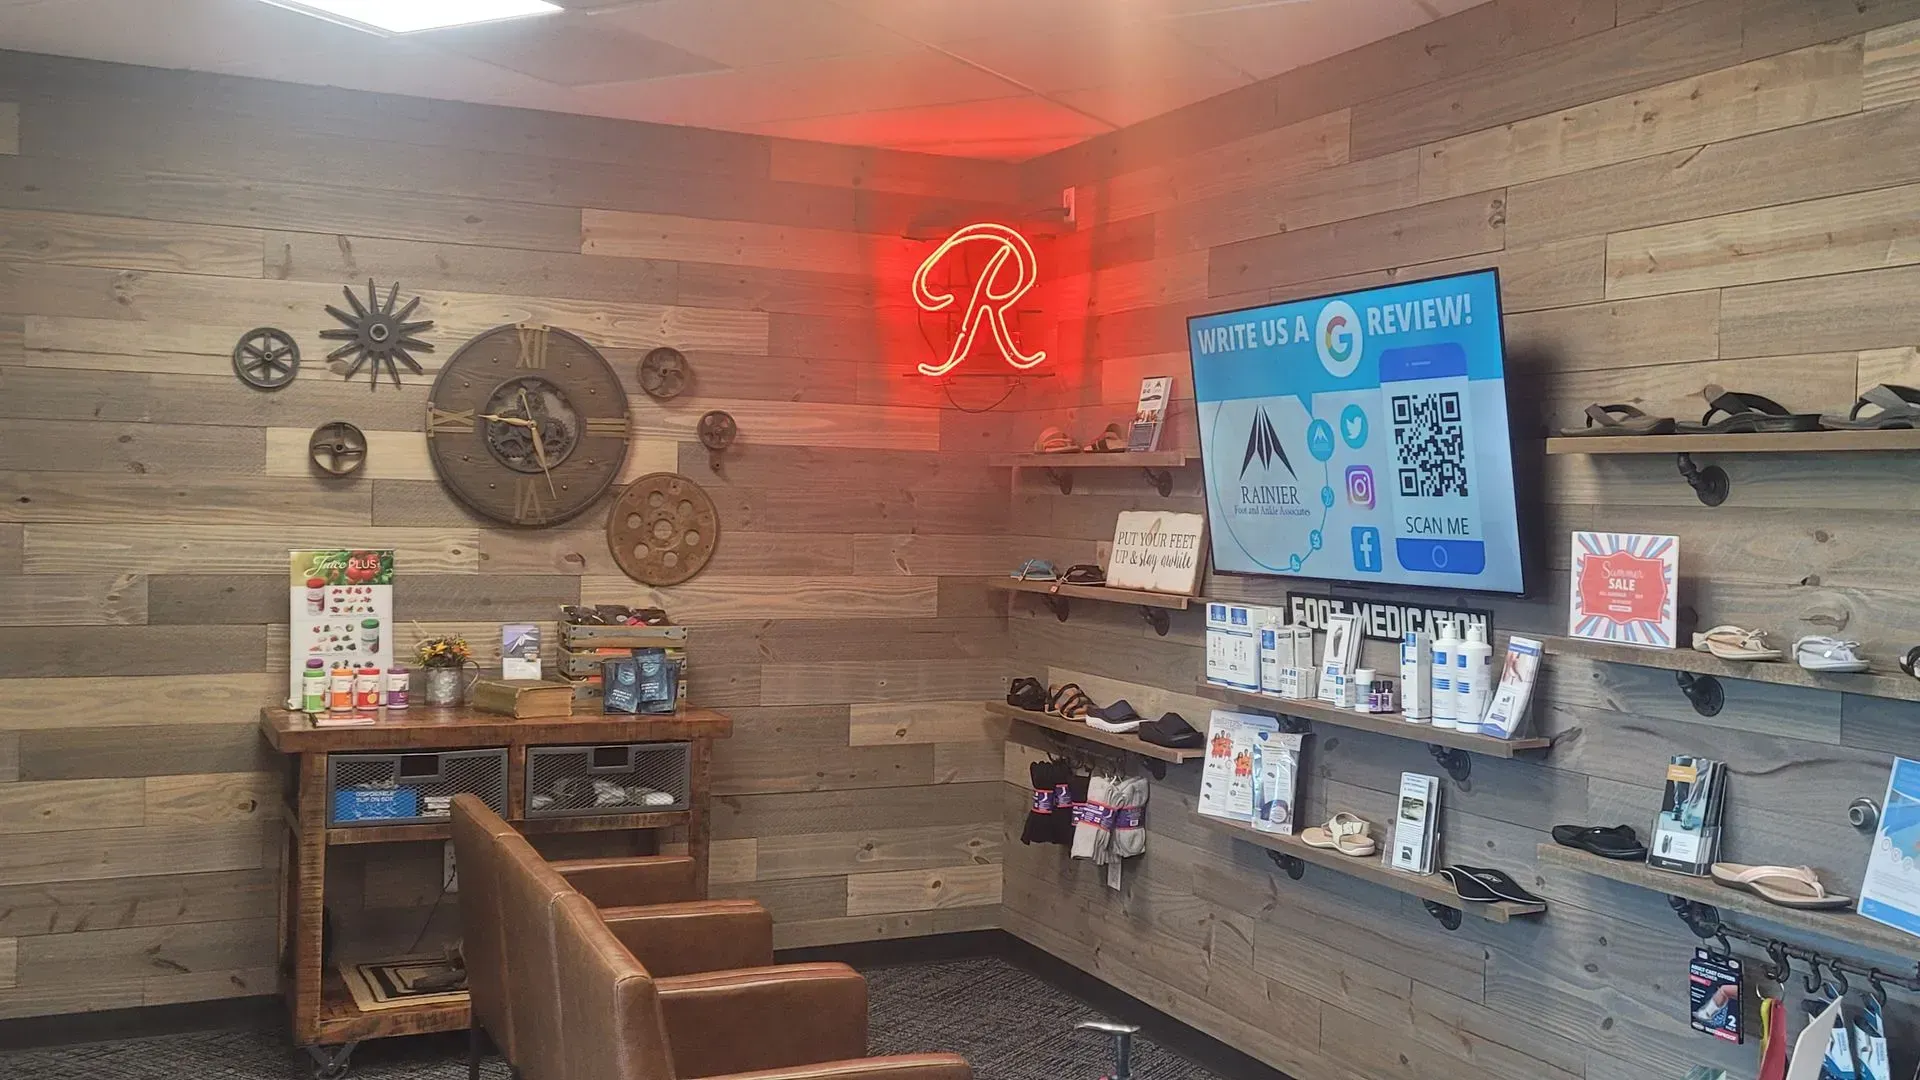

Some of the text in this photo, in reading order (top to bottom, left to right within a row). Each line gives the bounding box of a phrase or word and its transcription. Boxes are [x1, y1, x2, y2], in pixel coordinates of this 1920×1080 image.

[912, 223, 1046, 376] R
[1197, 322, 1258, 355] WRITE
[1261, 317, 1289, 347] US
[1294, 315, 1310, 343] A
[1366, 293, 1472, 336] REVIEW!
[1240, 485, 1301, 505] RAINIER
[1234, 505, 1311, 517] Foot and Ankle Associates
[1405, 516, 1470, 535] SCAN ME
[1117, 531, 1197, 549] PUT YOUR FEET
[304, 555, 347, 577] Juice
[1114, 548, 1193, 574] UP & stay awhile
[1601, 560, 1645, 579] Summer
[1608, 578, 1637, 591] SALE
[1351, 602, 1488, 644] MEDICATON
[1727, 1014, 1737, 1028] 2
